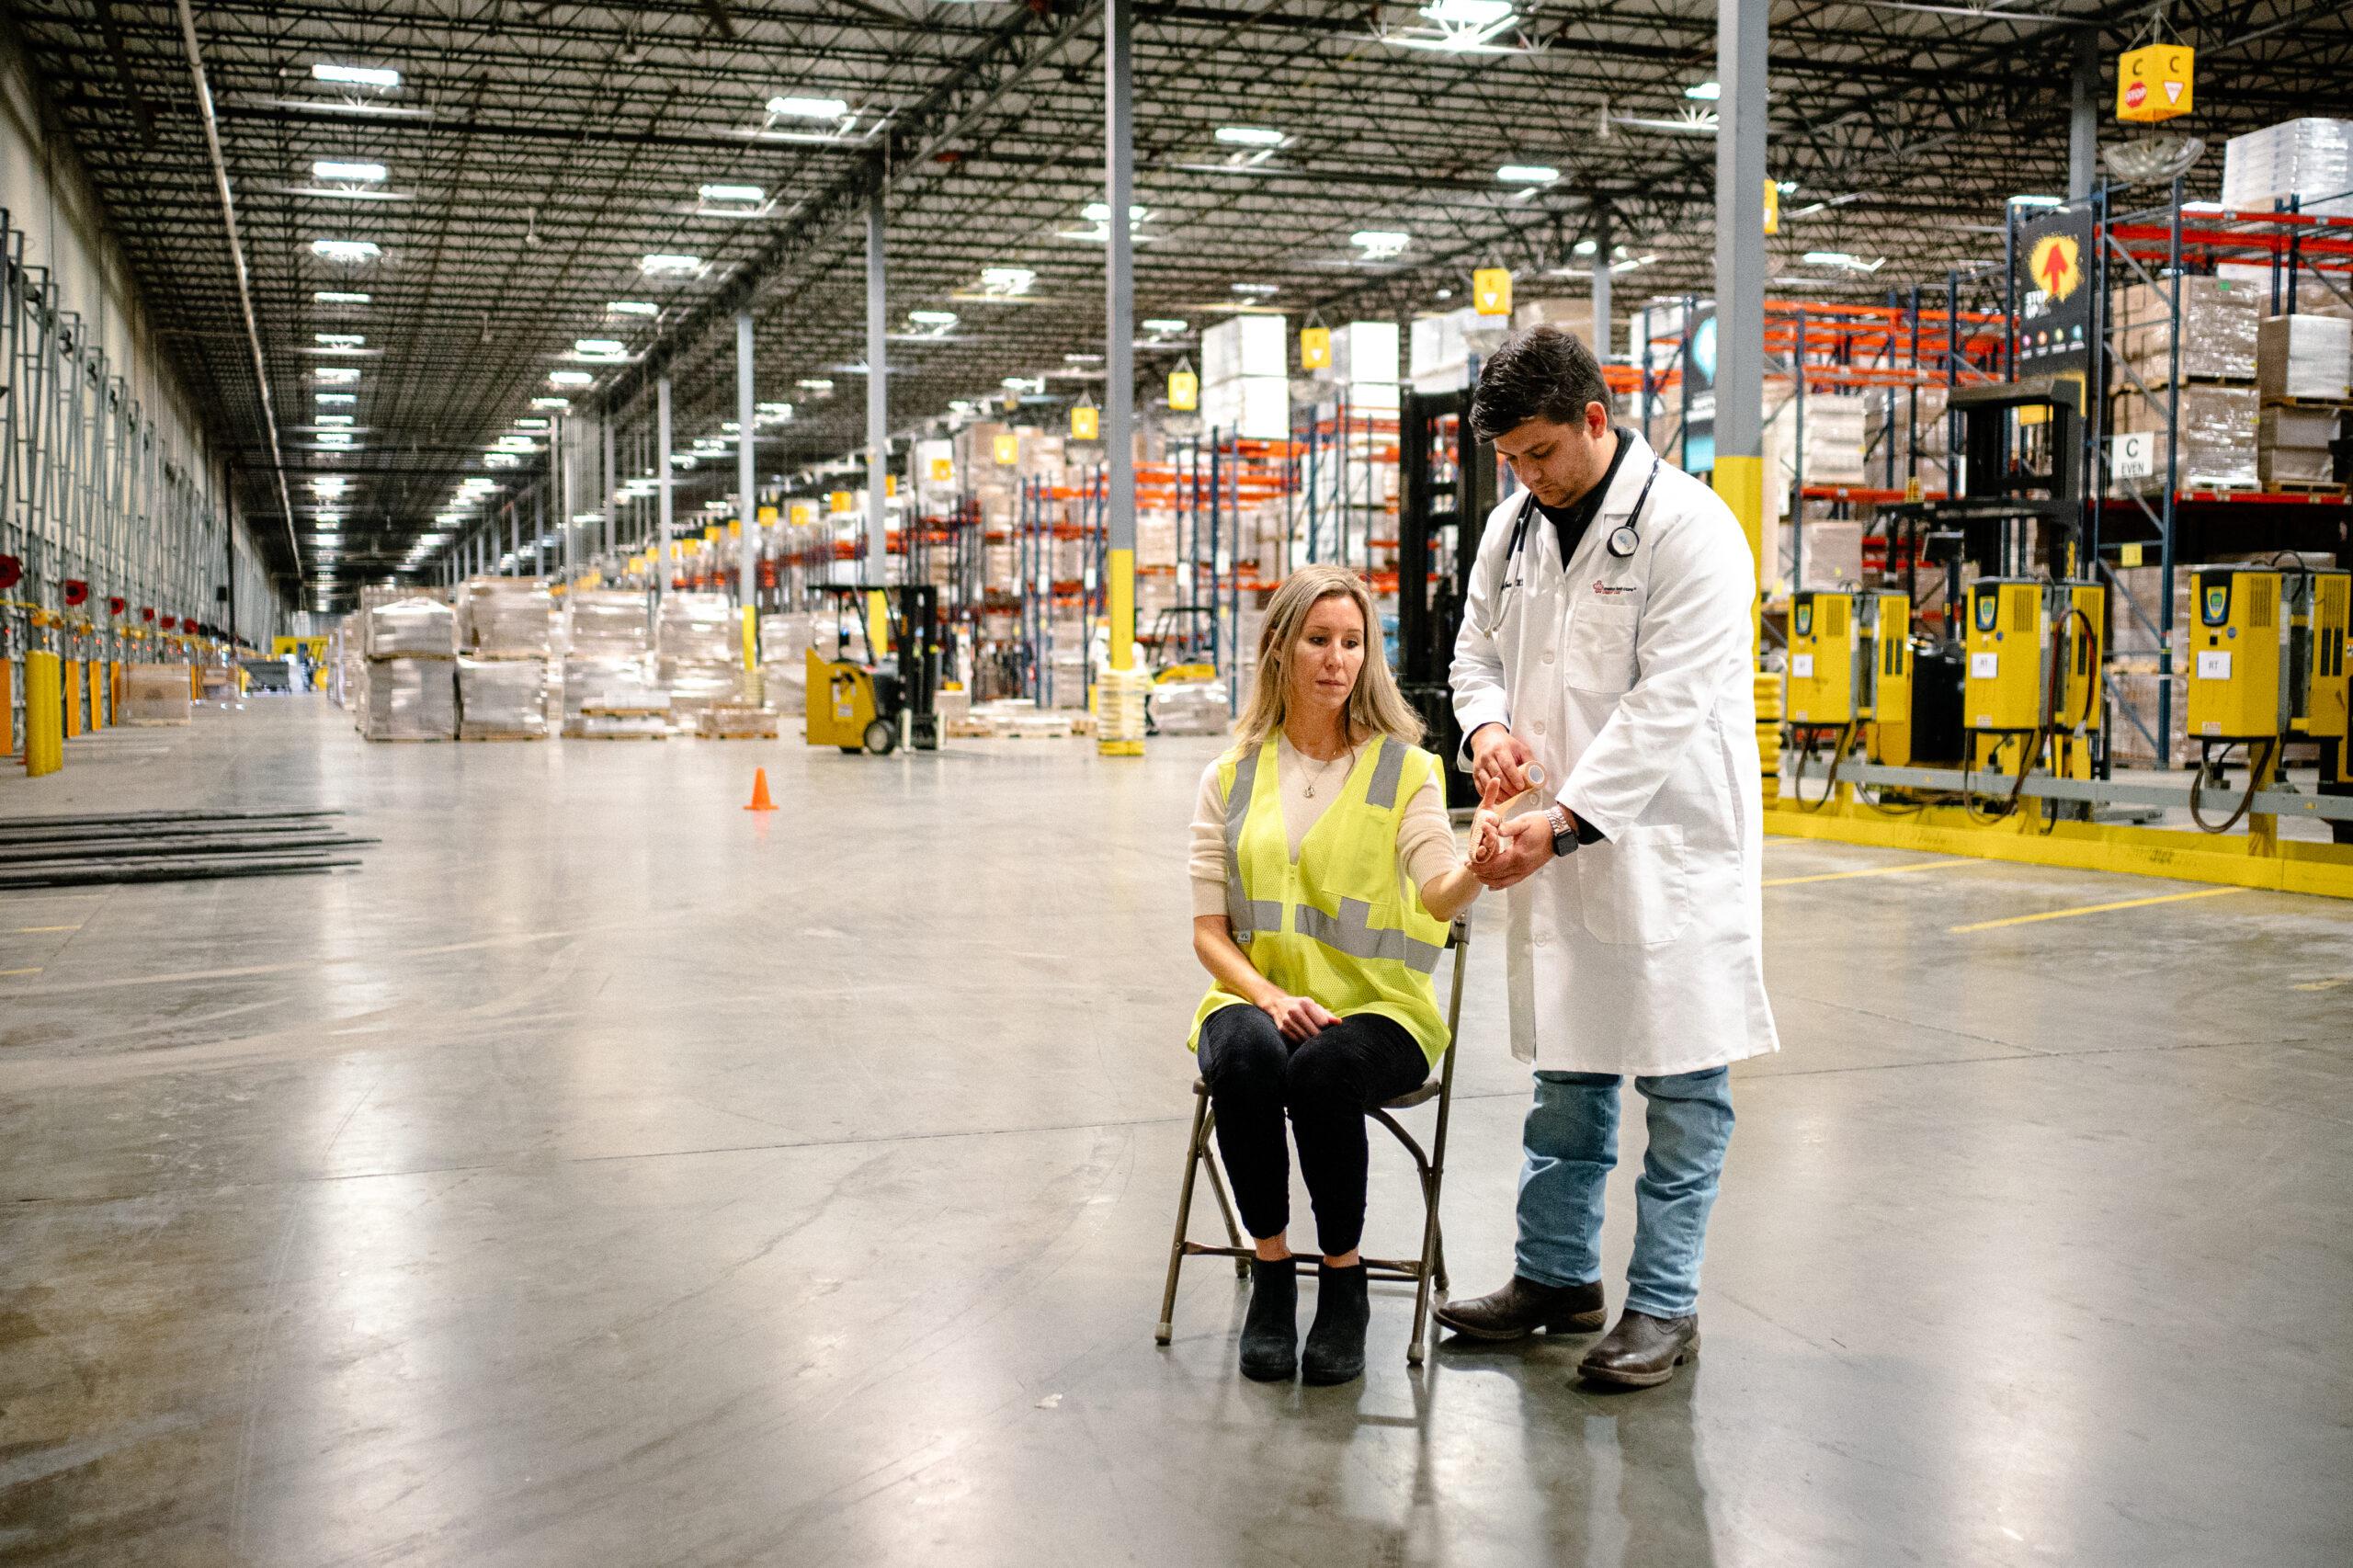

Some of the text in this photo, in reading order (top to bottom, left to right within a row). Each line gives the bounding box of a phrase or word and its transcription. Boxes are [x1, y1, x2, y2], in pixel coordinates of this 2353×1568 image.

[2132, 58, 2143, 76] C
[2169, 56, 2180, 74] C
[2126, 437, 2140, 459] C
[2121, 461, 2144, 475] EVEN
